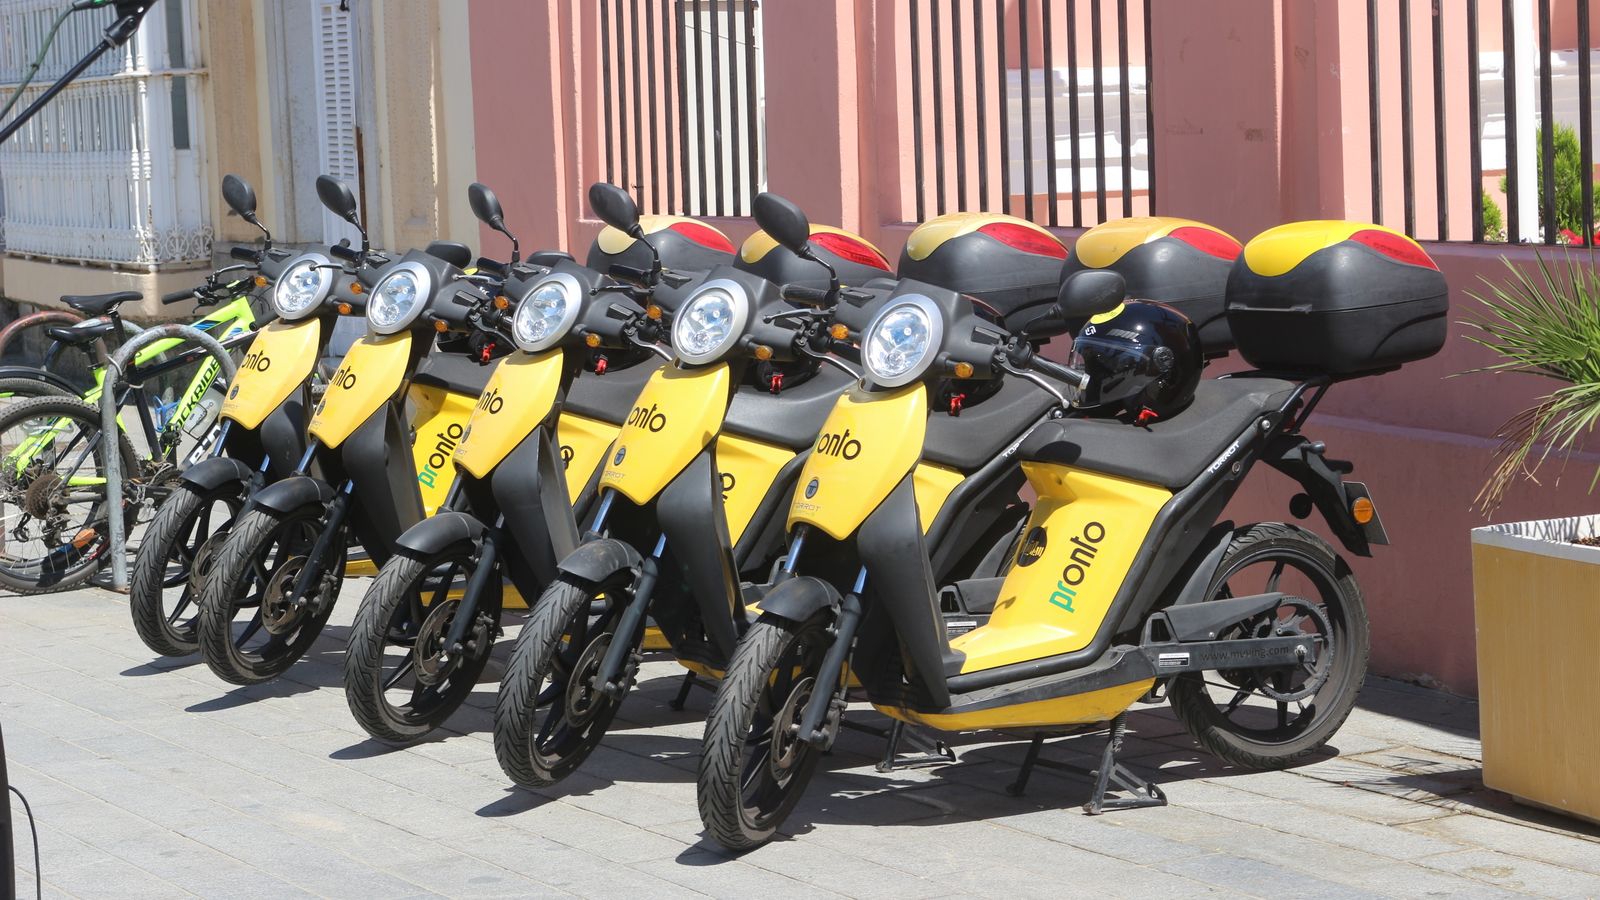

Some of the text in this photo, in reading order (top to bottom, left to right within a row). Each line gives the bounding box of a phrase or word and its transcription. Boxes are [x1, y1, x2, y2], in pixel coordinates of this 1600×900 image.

[627, 403, 667, 432] onto
[418, 423, 463, 489] pronto
[817, 429, 861, 460] onto
[1208, 440, 1240, 474] TORROT
[1049, 521, 1105, 614] pronto
